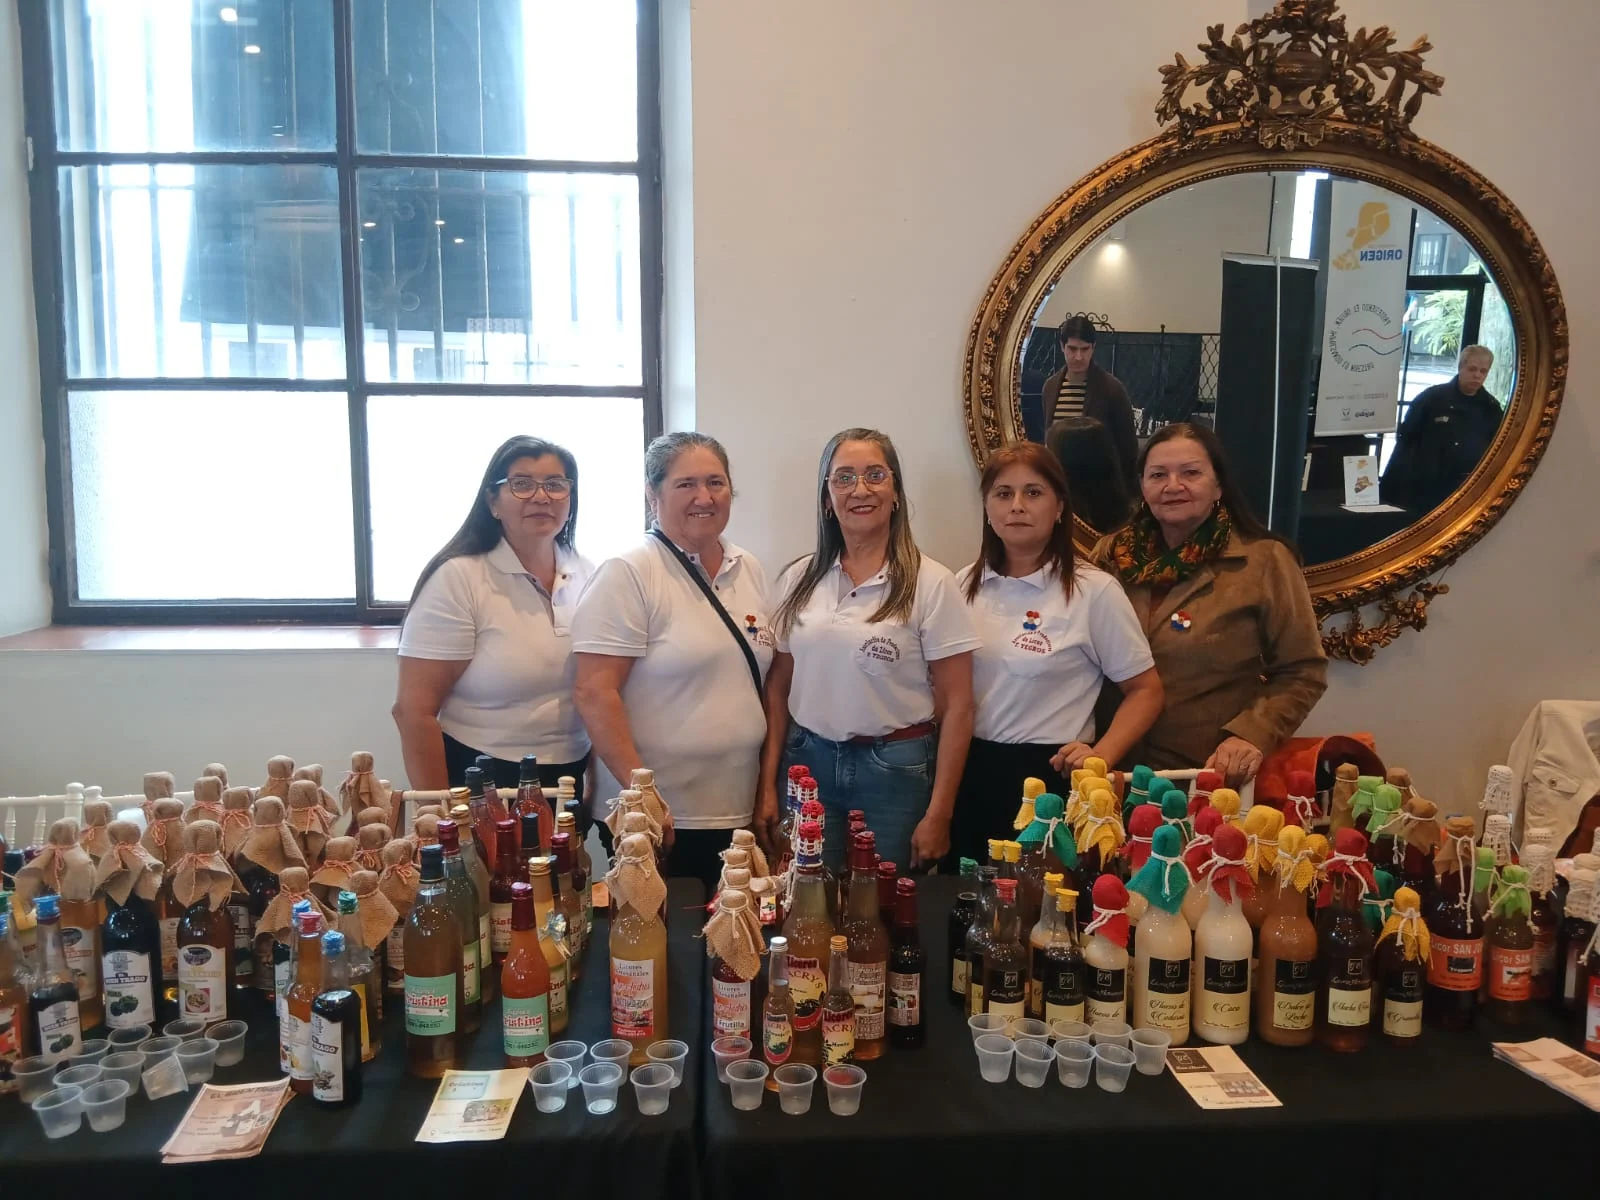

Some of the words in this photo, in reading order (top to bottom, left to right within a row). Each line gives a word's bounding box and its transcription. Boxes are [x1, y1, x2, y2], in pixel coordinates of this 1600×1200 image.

[1453, 943, 1471, 954] SAN
[787, 956, 817, 968] Licores
[406, 994, 448, 1007] ristina
[504, 1015, 543, 1027] ristina
[719, 1020, 745, 1028] Frutilla
